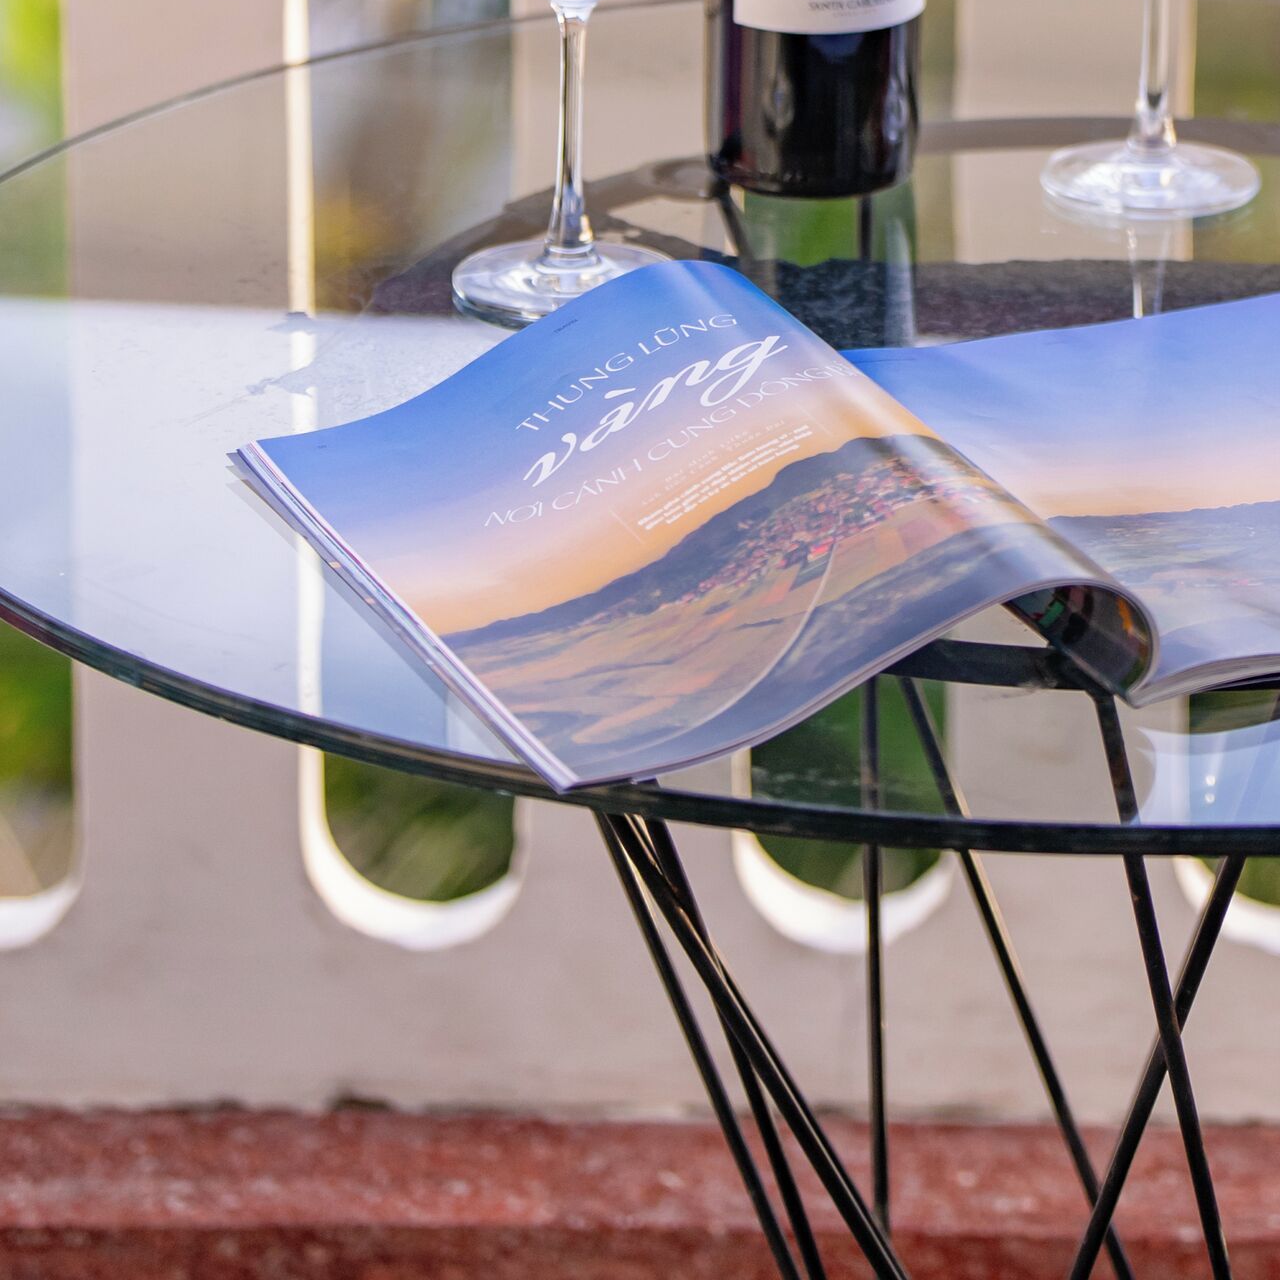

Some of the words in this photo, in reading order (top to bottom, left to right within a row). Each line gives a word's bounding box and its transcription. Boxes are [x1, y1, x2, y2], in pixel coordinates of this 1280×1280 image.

[515, 352, 635, 432] THUNG
[638, 314, 738, 355] LŨNG
[522, 335, 788, 488] vàng
[484, 500, 543, 527] NƠI
[552, 458, 643, 511] CÁNH
[648, 406, 736, 462] CUNG
